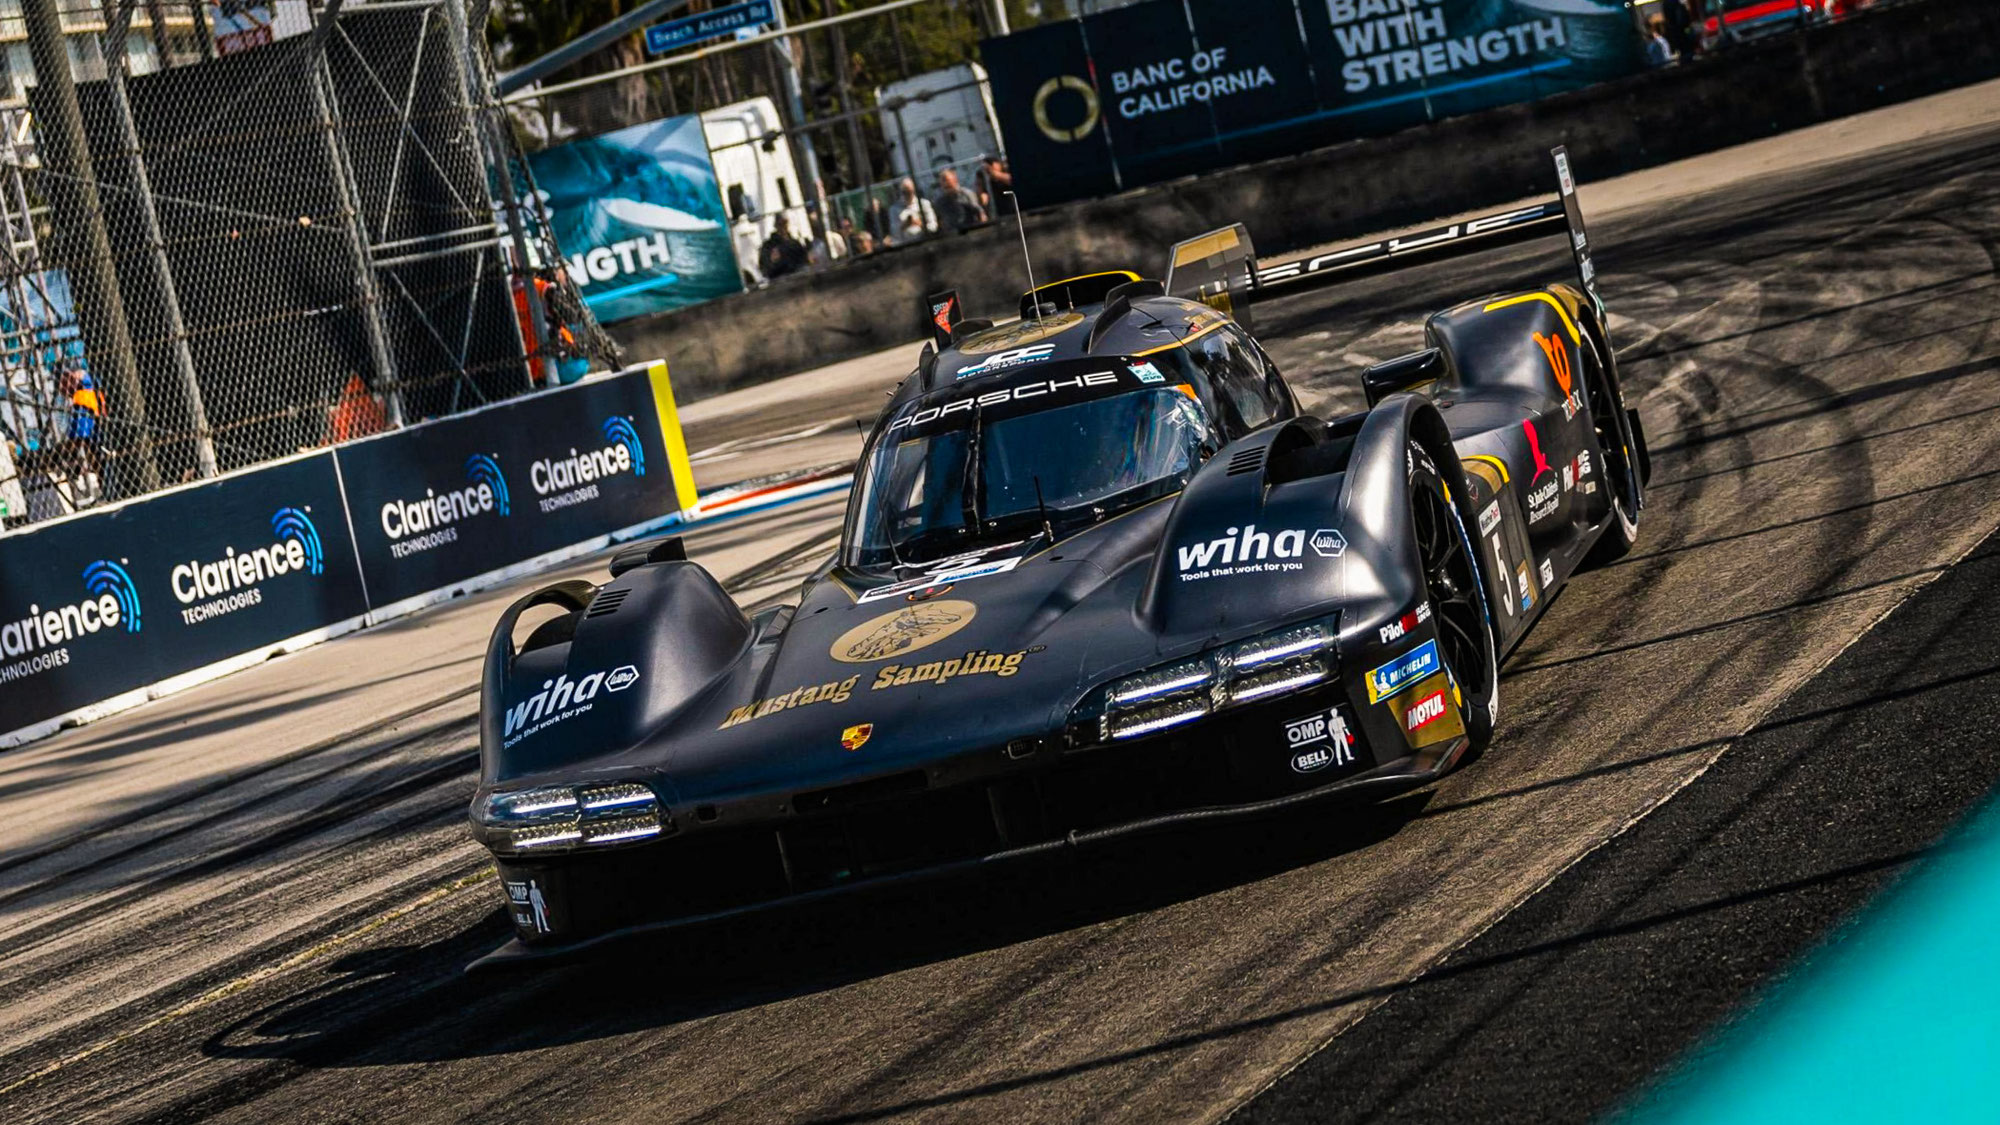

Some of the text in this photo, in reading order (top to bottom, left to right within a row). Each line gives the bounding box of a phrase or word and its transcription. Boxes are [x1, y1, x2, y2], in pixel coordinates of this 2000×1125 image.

[1327, 0, 1443, 25] BA
[1332, 6, 1447, 57] WITH
[1111, 47, 1227, 94] BANC OF
[1341, 15, 1566, 93] STRENGTH
[1119, 64, 1276, 119] CALIFORNIA
[888, 370, 1119, 434] PORSCHE
[530, 443, 631, 495] Clarience
[381, 482, 494, 539] Clarience
[539, 484, 600, 512] TECHNOLOGIES
[390, 527, 458, 558] TECHNOLOGIES
[1178, 524, 1306, 571] wiha
[171, 538, 305, 604] Clarience
[1180, 562, 1304, 582] Tools that work for you
[1491, 531, 1515, 616] 5
[0, 593, 120, 662] arience
[180, 588, 262, 626] TECHNOLOGIES
[1379, 619, 1405, 644] Pilot
[871, 650, 1028, 690] Sampling
[1389, 652, 1432, 685] MICHELIN
[503, 703, 593, 750] Tools that work for you
[504, 671, 606, 737] wiha
[716, 674, 861, 732] Mustang
[1408, 694, 1445, 730] MOTUL
[1287, 721, 1326, 743] OMP
[1297, 750, 1329, 768] BELL
[508, 885, 528, 900] OMP
